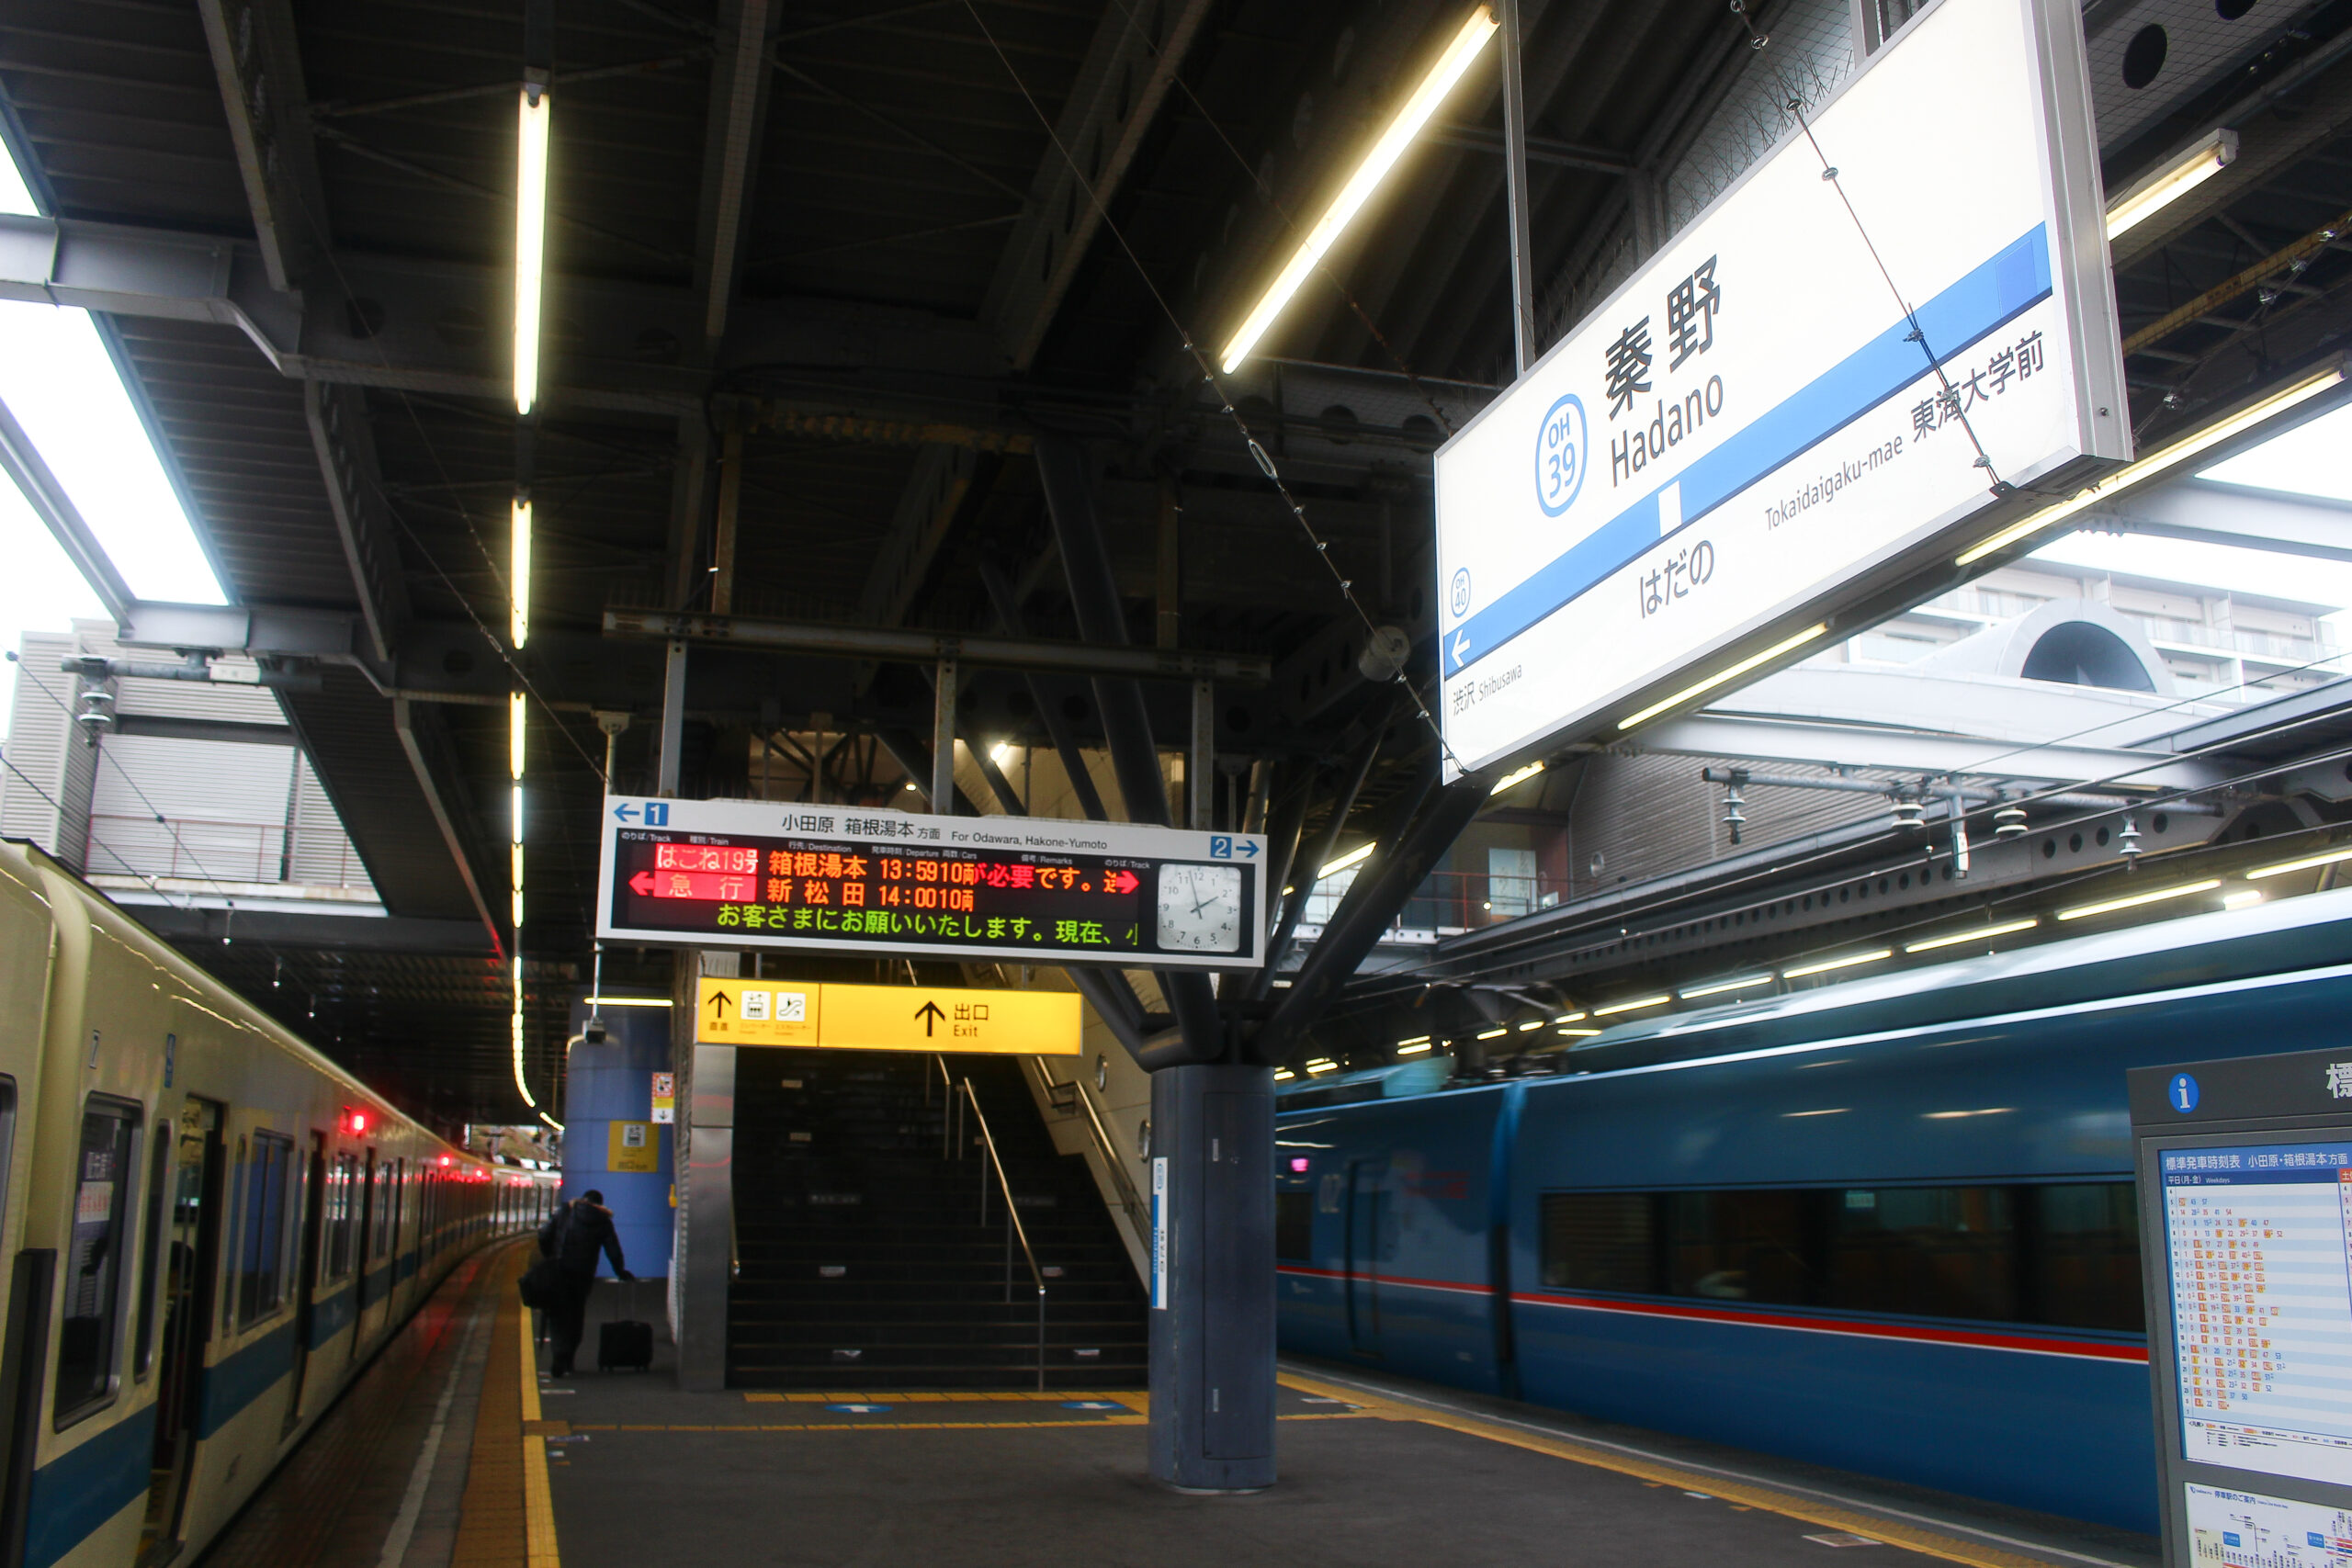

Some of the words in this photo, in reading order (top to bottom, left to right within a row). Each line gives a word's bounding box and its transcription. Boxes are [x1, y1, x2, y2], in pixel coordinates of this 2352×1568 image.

[1606, 254, 1721, 422] 秦野
[1548, 412, 1571, 449] OH
[1611, 374, 1724, 488] Hadano
[1764, 434, 1904, 531] Tokaidaigaku-mae
[1910, 330, 2045, 444] 東海大学前
[1549, 442, 1576, 499] 39
[1640, 539, 1714, 619] はだの
[1455, 588, 1467, 609] 40
[1453, 681, 1476, 716] 渋沢
[1478, 664, 1522, 702] Shibusawa
[649, 804, 661, 825] 1
[782, 813, 835, 834] 小田原
[844, 817, 915, 839] 箱根湯本
[916, 828, 941, 840] 方面
[951, 830, 969, 843] For
[972, 832, 1023, 847] Odawara,
[1025, 835, 1108, 851] Hakone-Yumoto
[1214, 838, 1228, 857] 2
[768, 850, 868, 880] 箱根湯本
[766, 877, 865, 908] 新松田
[954, 1002, 989, 1021] 出口
[954, 1023, 978, 1037] Exit
[2165, 1155, 2241, 1171] 標準発車時刻表
